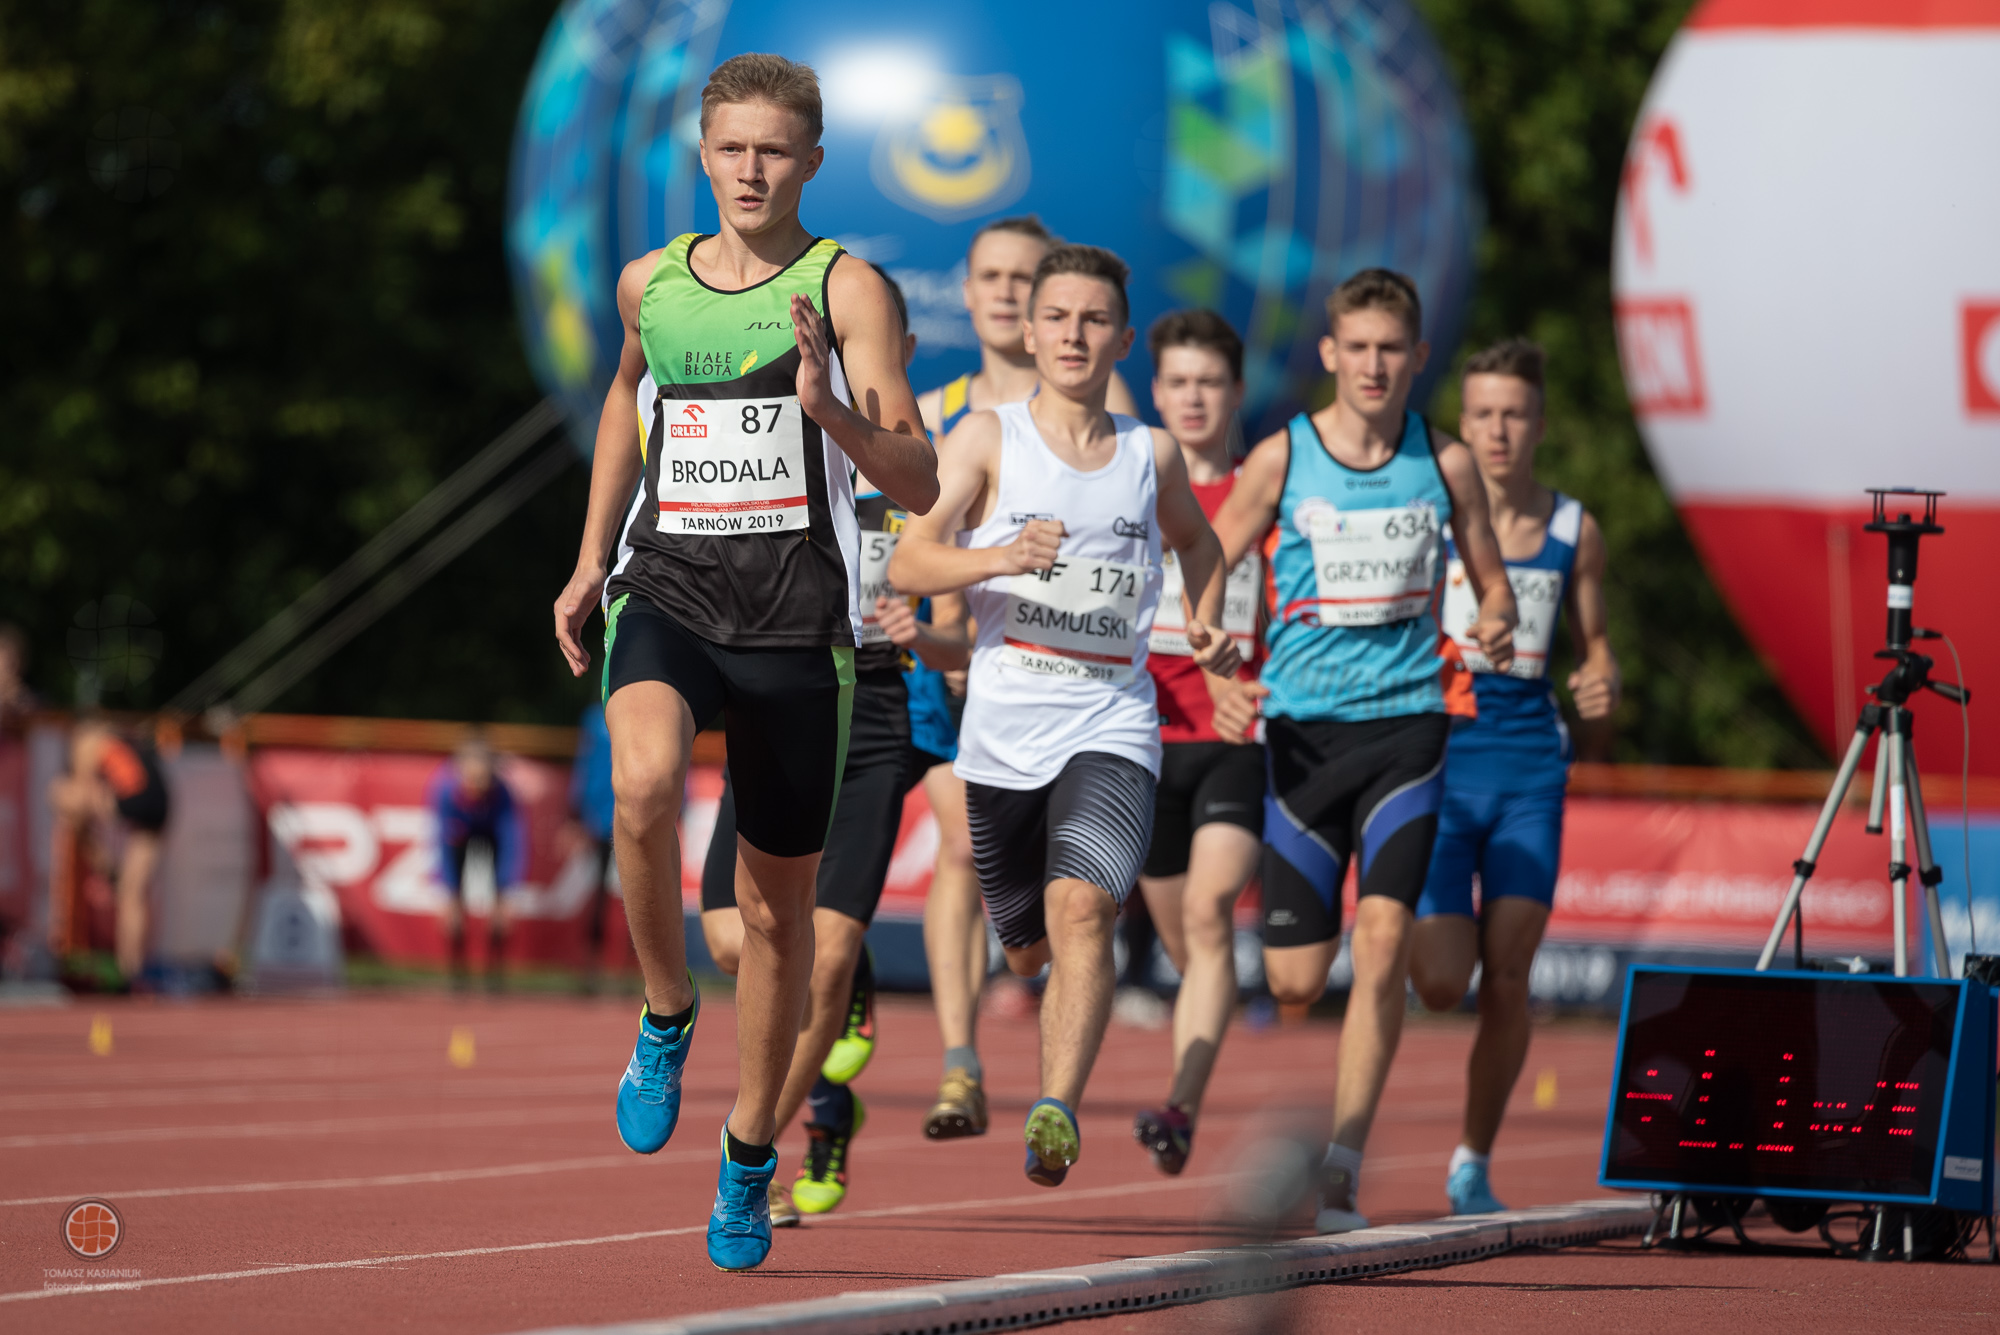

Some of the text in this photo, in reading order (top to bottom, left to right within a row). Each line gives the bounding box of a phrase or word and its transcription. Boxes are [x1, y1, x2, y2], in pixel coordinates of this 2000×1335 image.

[685, 351, 732, 363] BIAŁE
[685, 363, 732, 376] BŁOTA
[671, 425, 706, 437] ORLEN
[741, 403, 783, 434] 87
[672, 456, 790, 484] BRODALA
[681, 514, 784, 531] TARNÓW 2019
[1384, 508, 1432, 540] 634
[1090, 566, 1135, 597] 171
[1015, 603, 1128, 640] SAMULSKI
[1020, 655, 1115, 679] TARNÓW 2019
